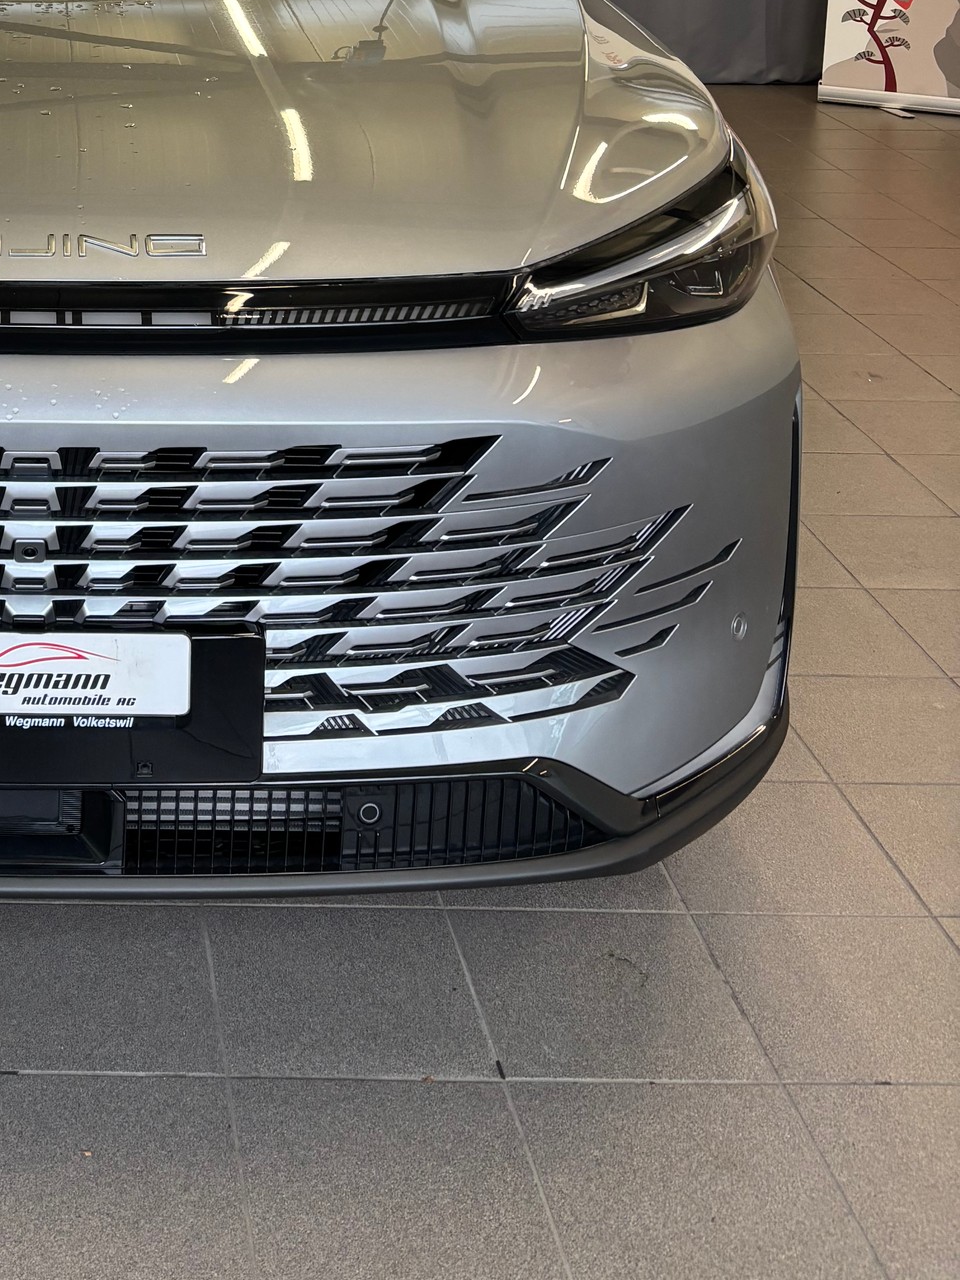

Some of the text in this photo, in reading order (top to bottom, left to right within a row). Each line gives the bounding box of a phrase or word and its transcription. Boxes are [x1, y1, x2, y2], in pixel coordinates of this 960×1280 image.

[21, 693, 112, 706] automobile
[5, 715, 65, 728] Wegmann
[72, 716, 135, 728] Volketswil
